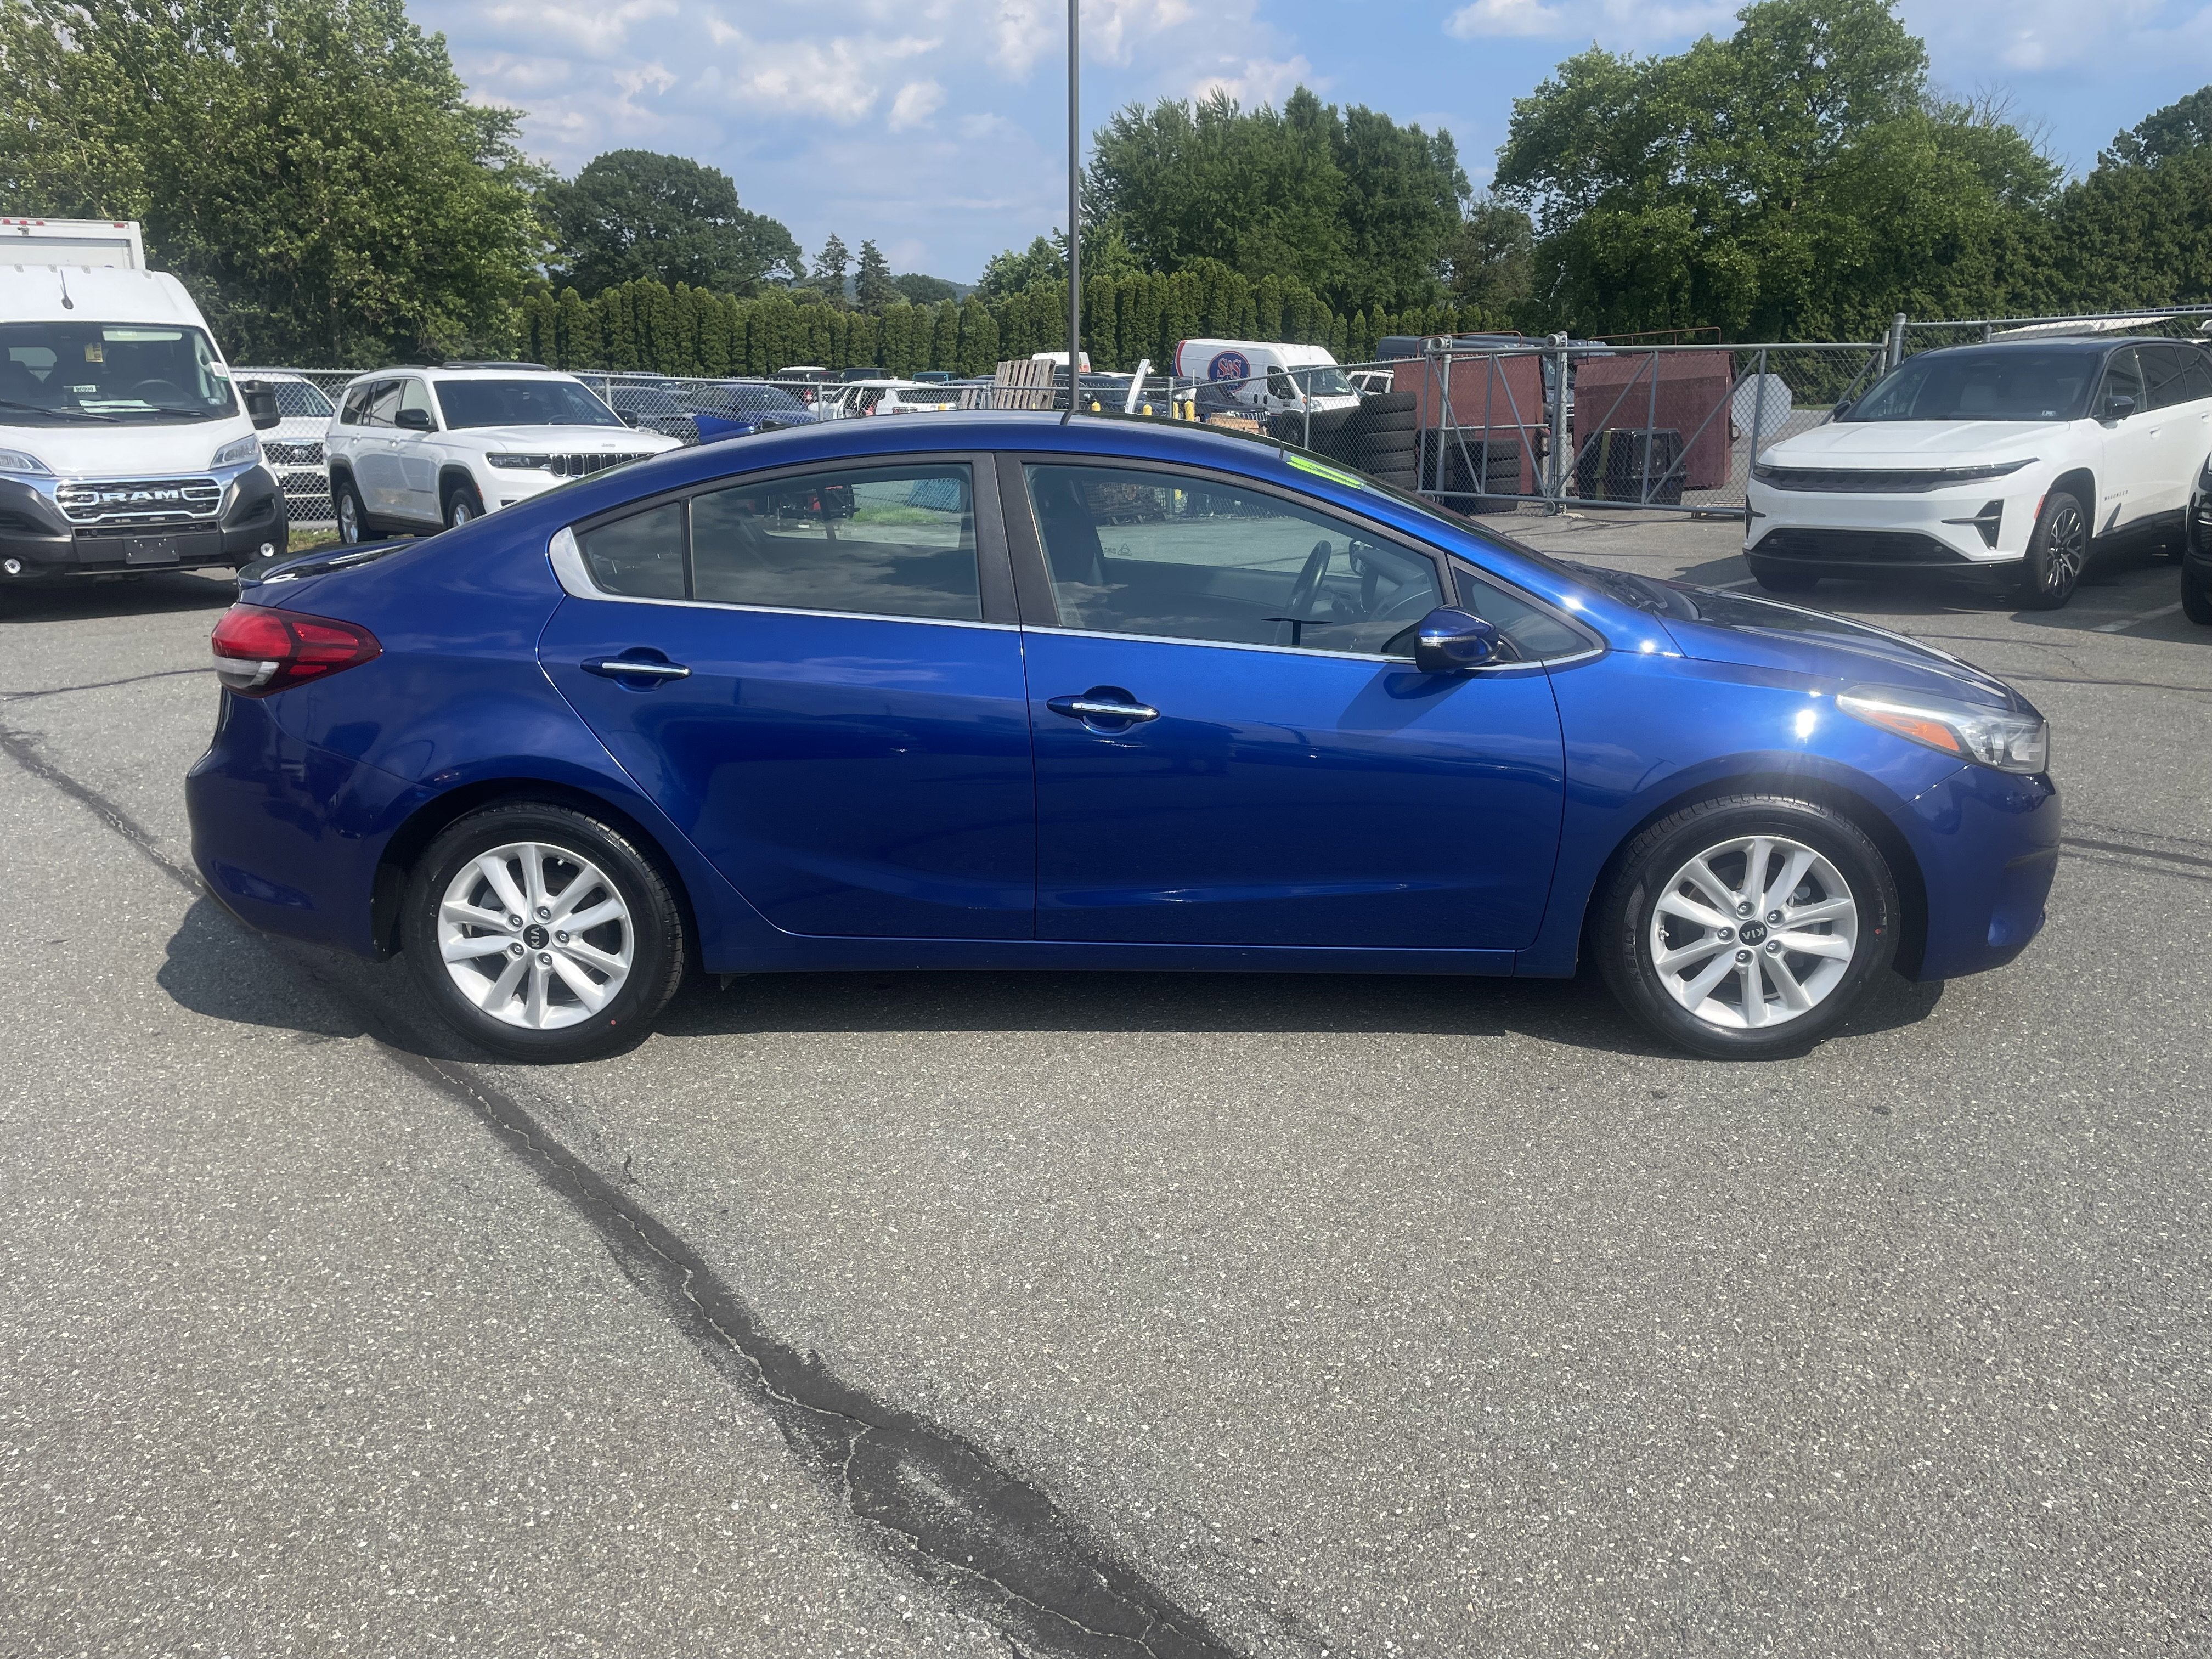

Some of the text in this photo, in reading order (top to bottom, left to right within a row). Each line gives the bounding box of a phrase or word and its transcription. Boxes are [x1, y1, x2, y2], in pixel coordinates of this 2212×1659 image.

[101, 490, 179, 501] RAM
[531, 927, 540, 947] KIA
[1742, 927, 1765, 940] KIA
